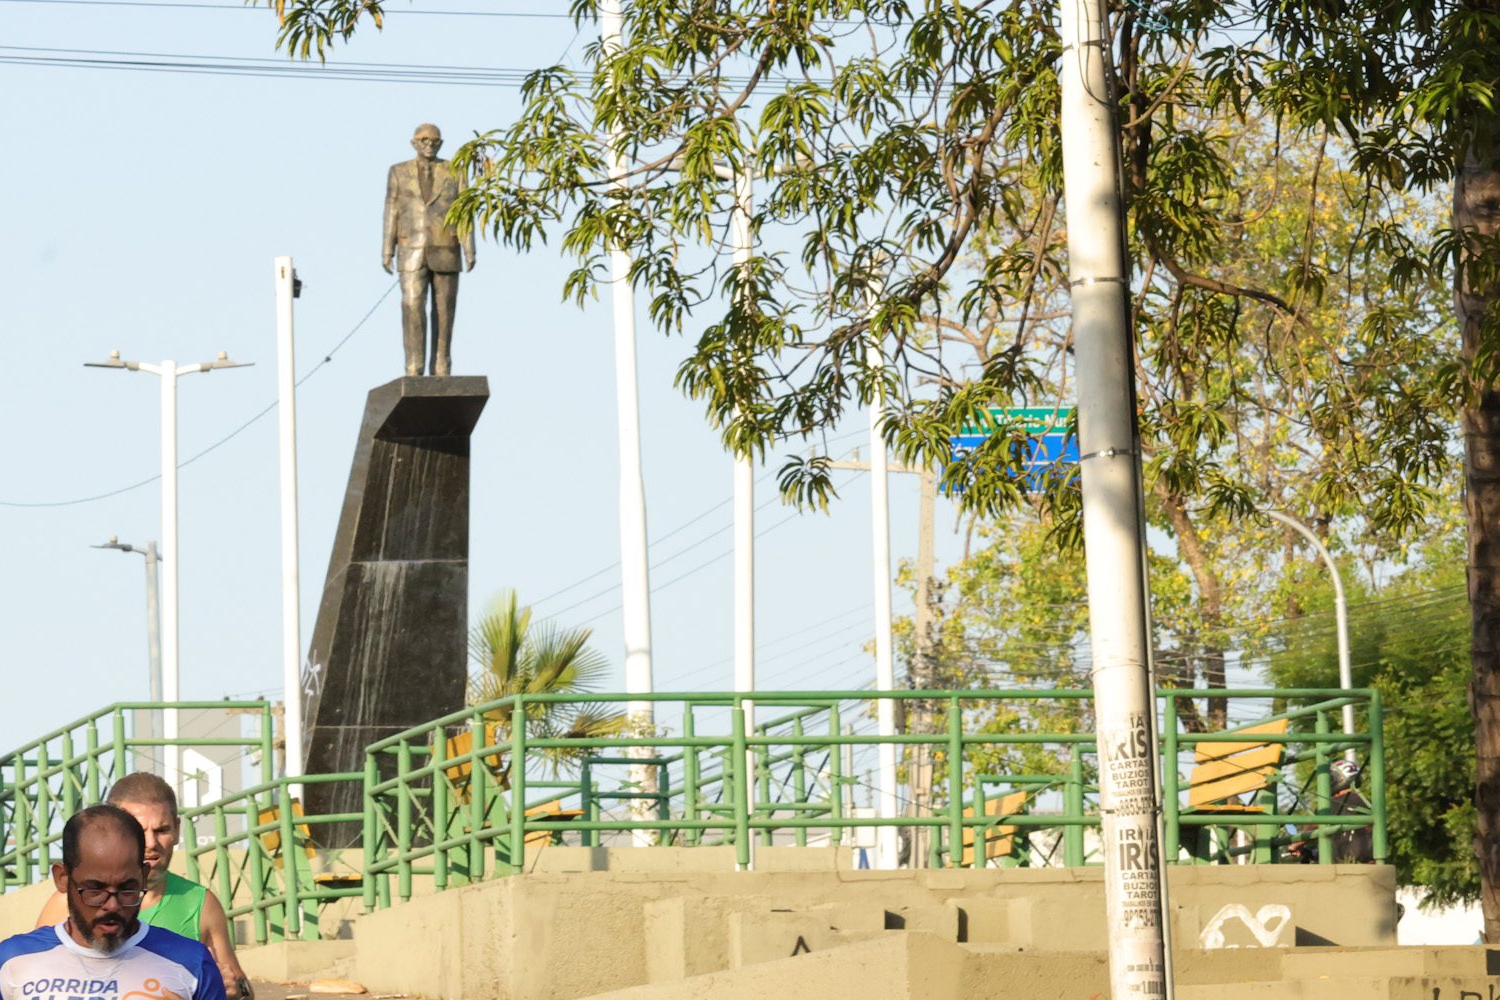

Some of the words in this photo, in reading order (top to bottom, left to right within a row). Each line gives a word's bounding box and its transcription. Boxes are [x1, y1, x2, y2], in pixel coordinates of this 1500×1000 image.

[1110, 759, 1149, 771] CARTAS
[1116, 779, 1148, 789] TAROT
[23, 978, 118, 996] CORRIDA
